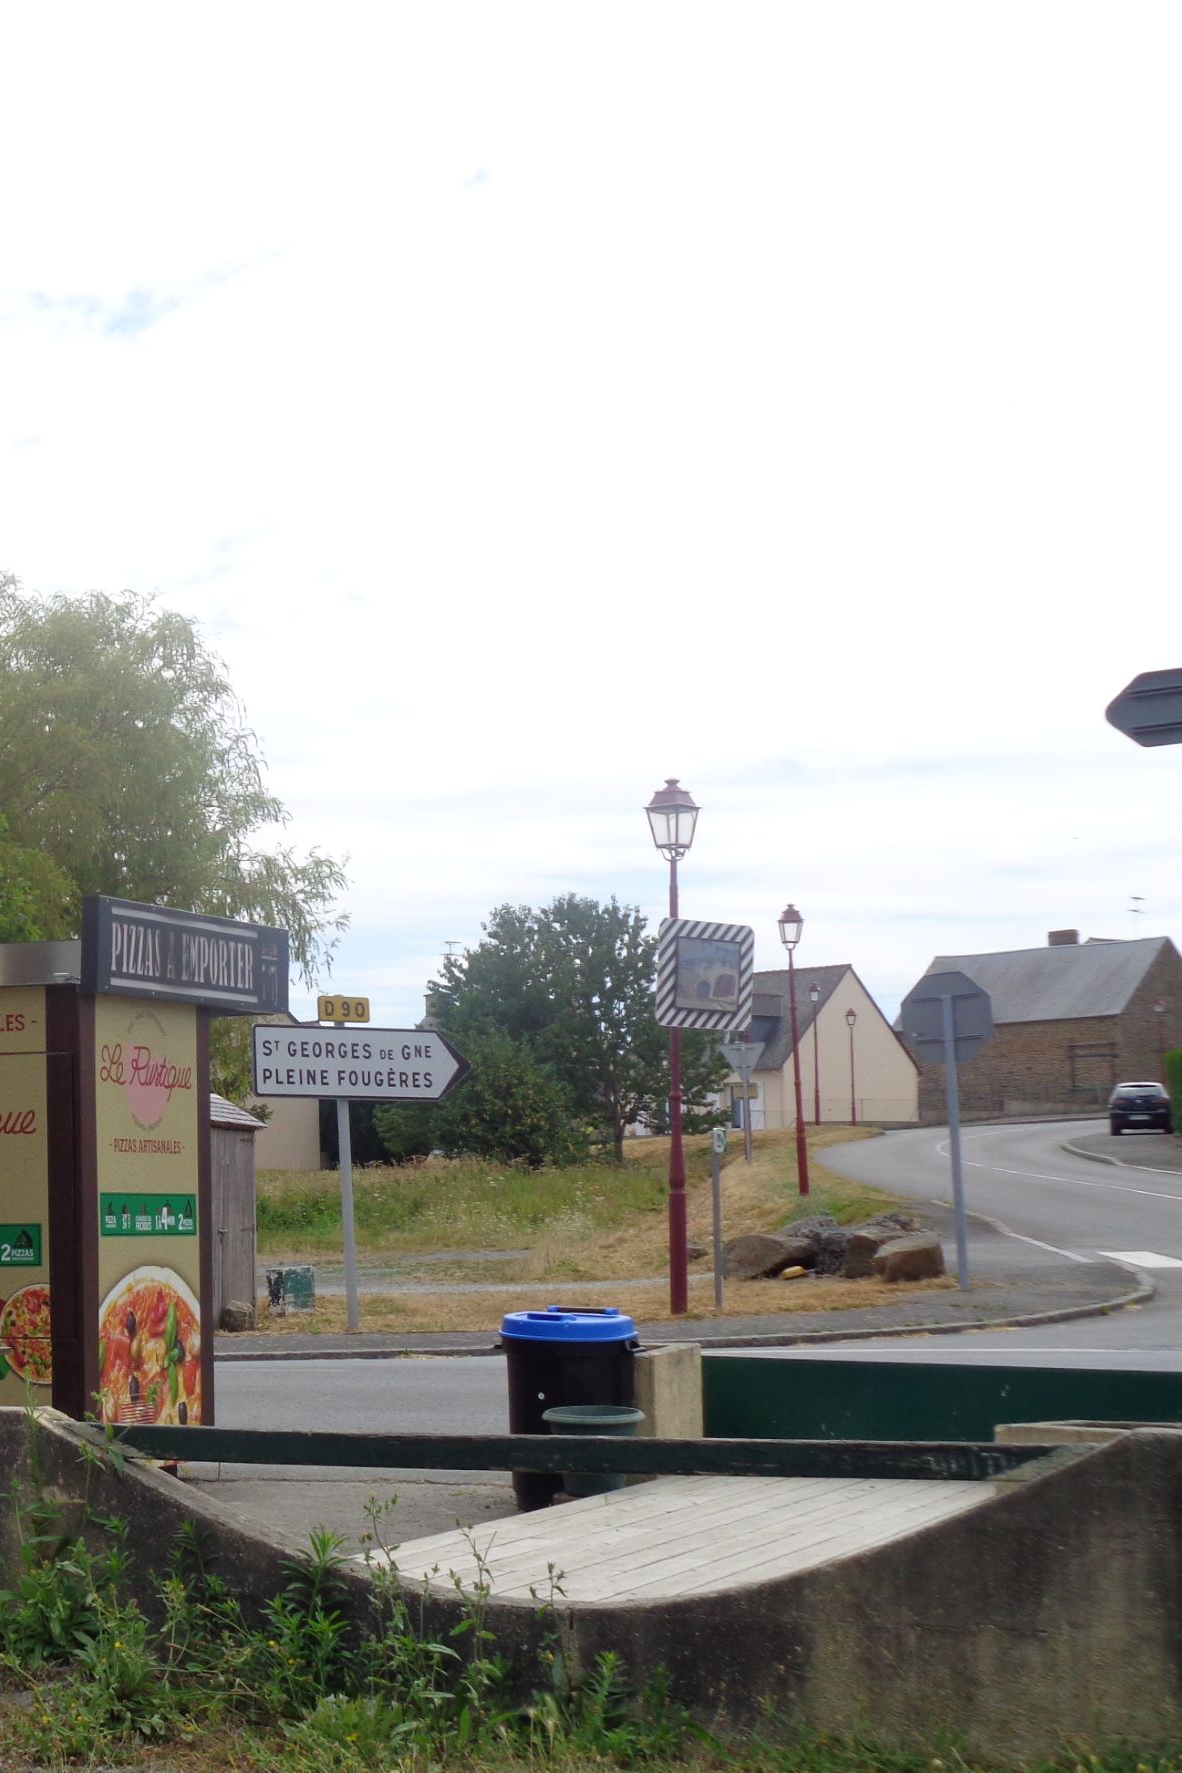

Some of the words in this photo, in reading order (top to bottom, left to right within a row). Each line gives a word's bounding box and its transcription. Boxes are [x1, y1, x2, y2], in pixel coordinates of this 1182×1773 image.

[111, 921, 161, 977] PIZZAS
[182, 933, 254, 990] EMPORTER
[324, 1000, 335, 1017] D
[341, 1001, 366, 1018] 90
[287, 1041, 372, 1060] GEORGES
[380, 1049, 394, 1060] DE
[402, 1044, 432, 1059] GNE
[100, 1043, 126, 1086] Le
[129, 1046, 192, 1102] Rustique
[262, 1068, 329, 1085] PLEINE
[337, 1067, 433, 1089] FOUGÈRES
[114, 1138, 137, 1153] PIZZAS
[138, 1139, 182, 1155] ARTISANALES
[0, 1243, 11, 1261] 2
